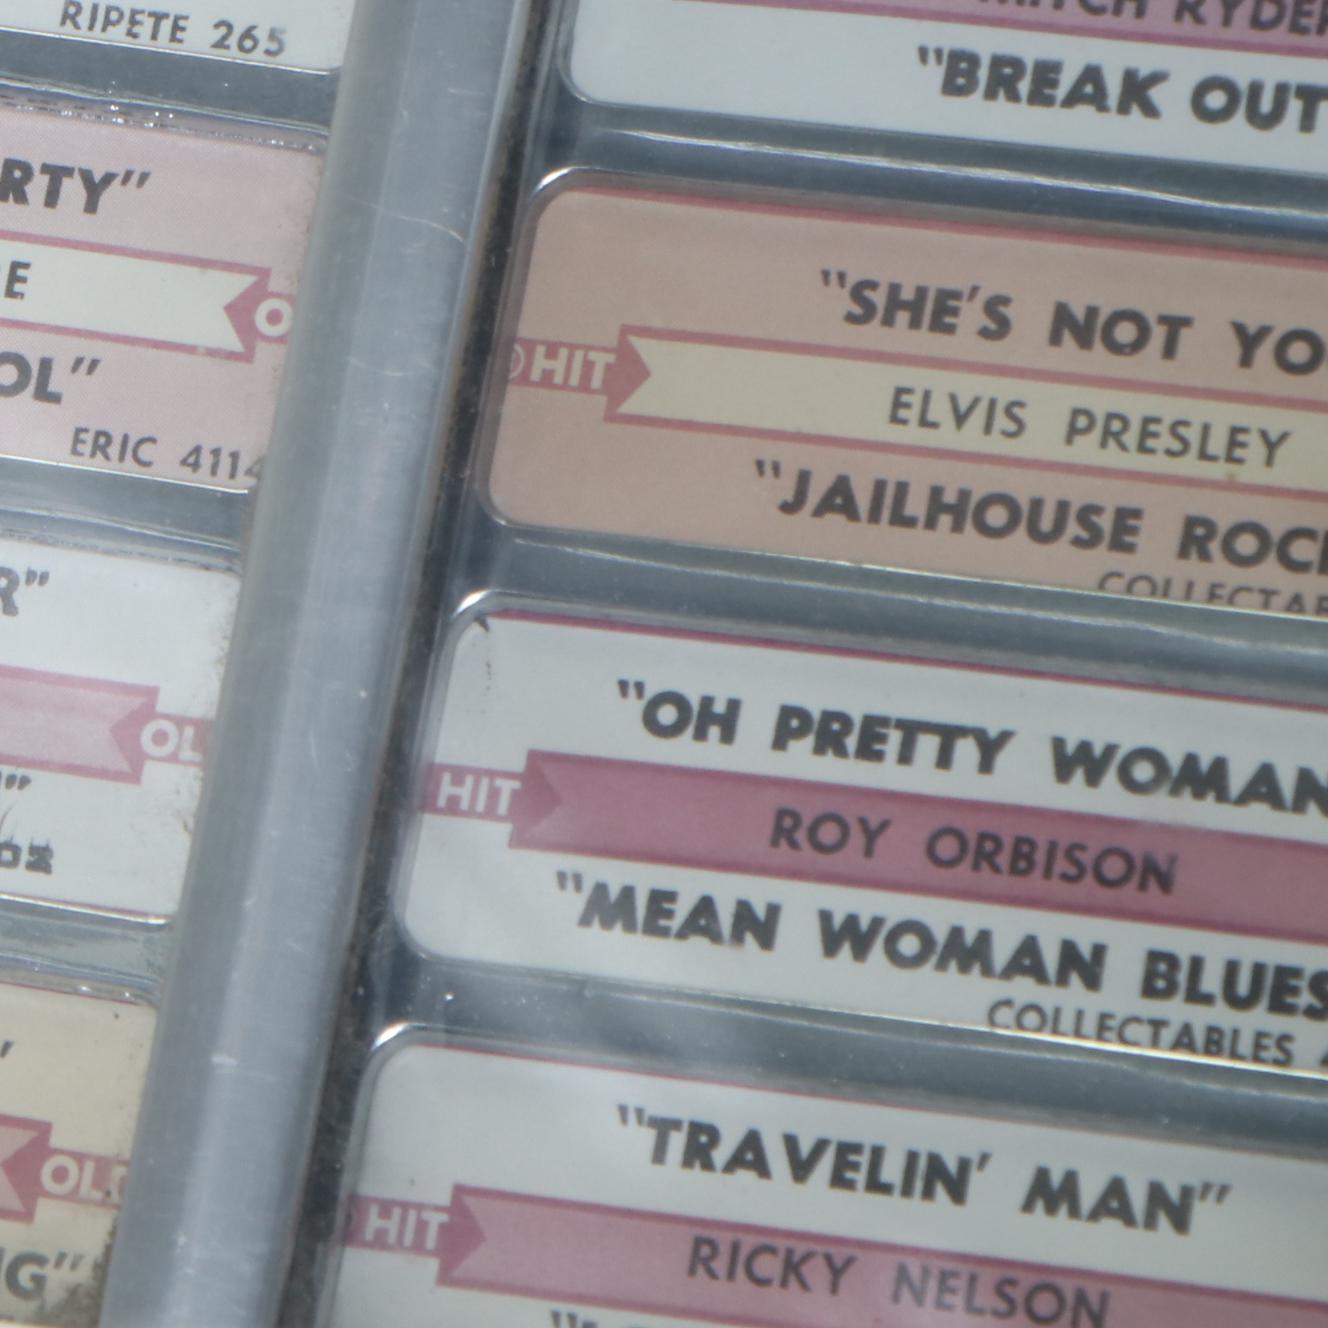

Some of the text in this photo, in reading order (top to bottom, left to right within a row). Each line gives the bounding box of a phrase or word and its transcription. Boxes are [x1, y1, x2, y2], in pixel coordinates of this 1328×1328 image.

[210, 18, 286, 58] 265
[917, 44, 1171, 120] "BREAK
[820, 268, 1013, 342] "SHE'S
[888, 385, 1291, 468] ELVIS PRESLEY
[754, 458, 1145, 554] "JAILHOUSE
[616, 677, 1017, 775] "OH PRETTY
[769, 806, 1177, 895] ROY ORBISON
[556, 869, 1109, 993] "MEAN WOMAN
[617, 1103, 1231, 1236] "TRAVELIN' MAN"
[687, 1234, 857, 1296] RICKY
